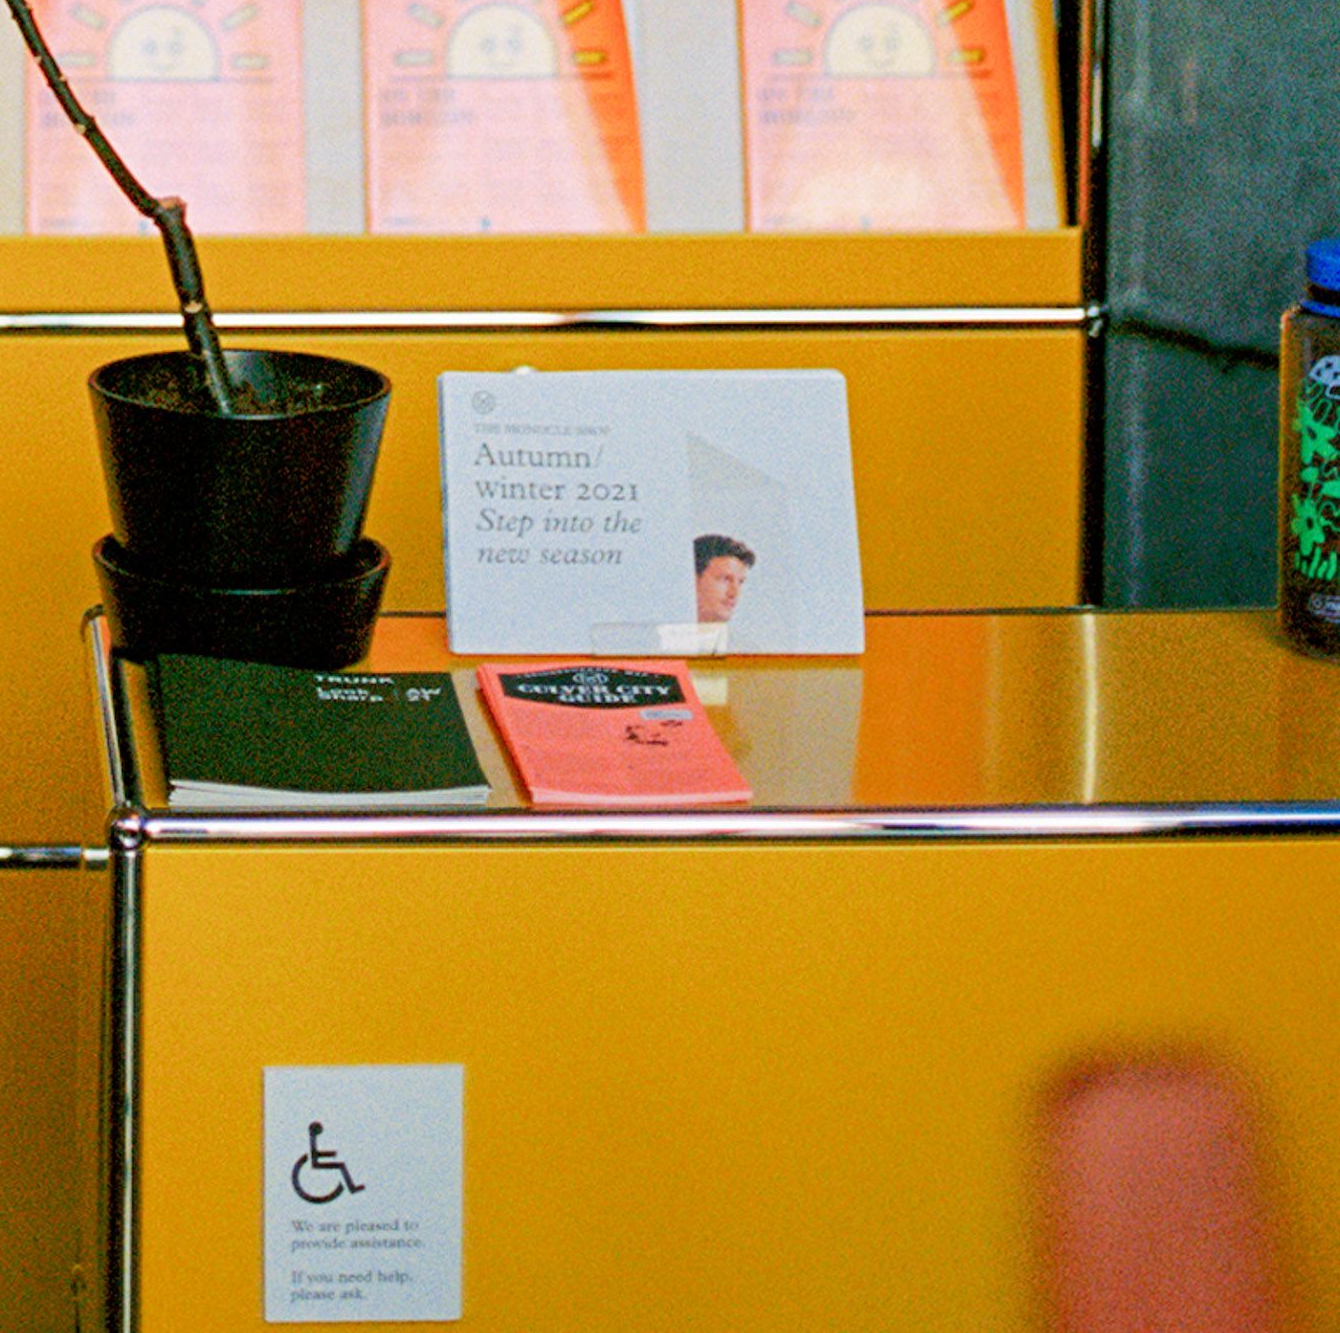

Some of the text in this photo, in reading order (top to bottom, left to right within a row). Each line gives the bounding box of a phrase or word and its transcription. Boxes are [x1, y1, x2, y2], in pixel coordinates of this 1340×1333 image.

[474, 442, 604, 469] Autumn/
[577, 483, 639, 502] 2021
[475, 507, 643, 539] Step into the
[477, 546, 623, 566] new season
[517, 683, 671, 696] CULVER CITY
[291, 1218, 420, 1235] We are pleased to
[291, 1237, 346, 1253] provide
[291, 1270, 304, 1284] If
[306, 1273, 334, 1285] you
[338, 1270, 373, 1284] need
[290, 1287, 336, 1304] please
